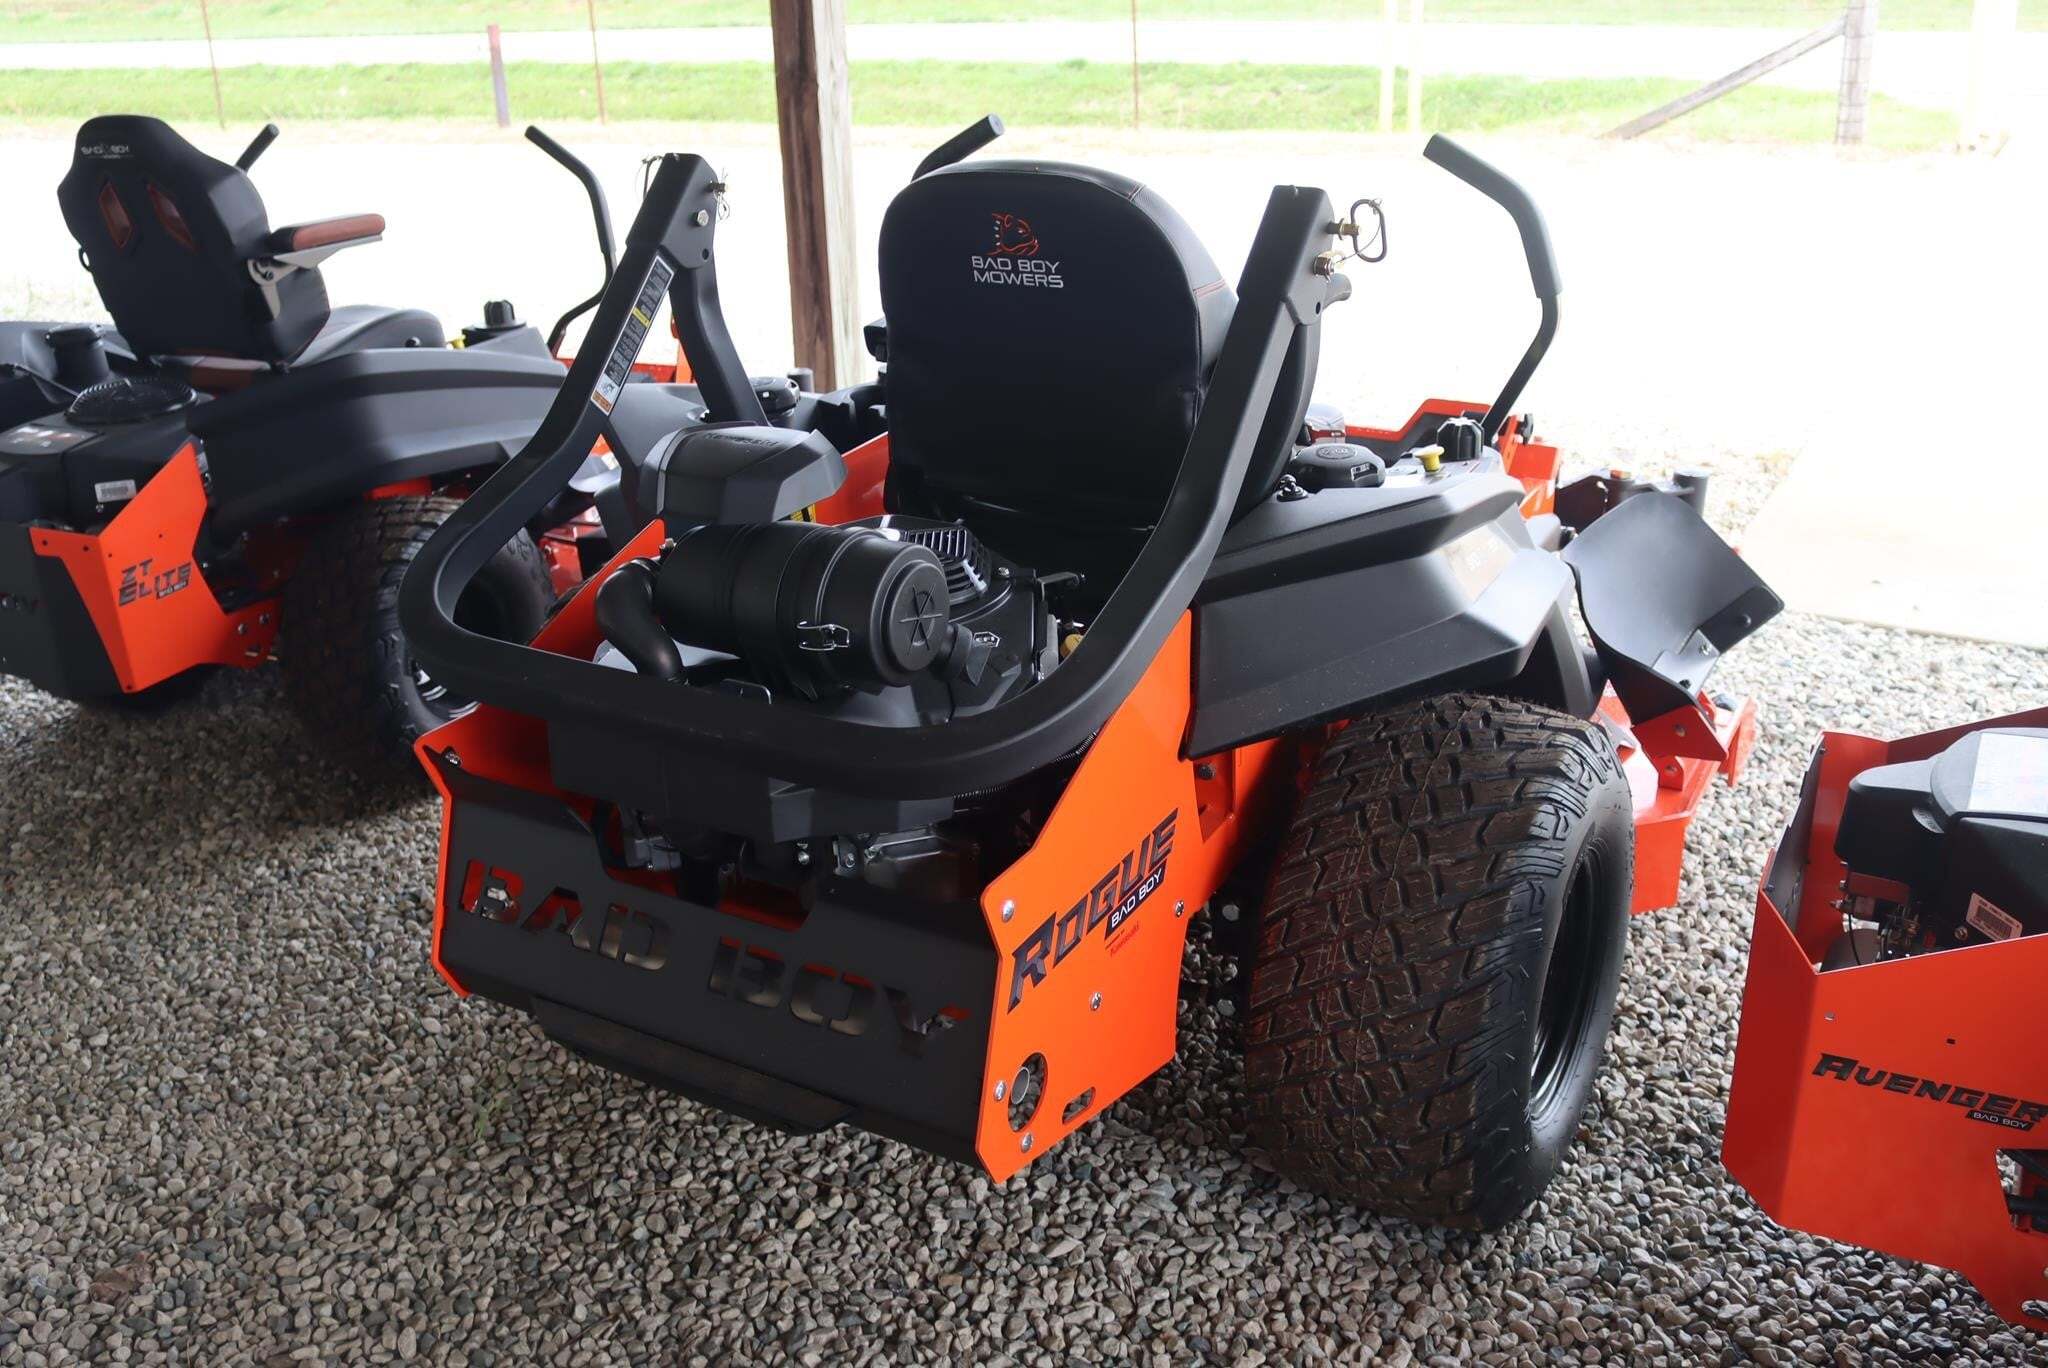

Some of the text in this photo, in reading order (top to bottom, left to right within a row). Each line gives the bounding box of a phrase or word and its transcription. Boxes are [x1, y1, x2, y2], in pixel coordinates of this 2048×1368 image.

[971, 255, 1060, 274] BAD BOY
[973, 270, 1064, 289] MOWERS
[121, 558, 153, 584] ZT
[1007, 807, 1179, 1015] ROGUE
[1111, 895, 1136, 929] BAD
[1138, 867, 1163, 901] BOY
[459, 858, 973, 1052] BAD BOY
[1973, 1111, 2029, 1129] BAD BOY
